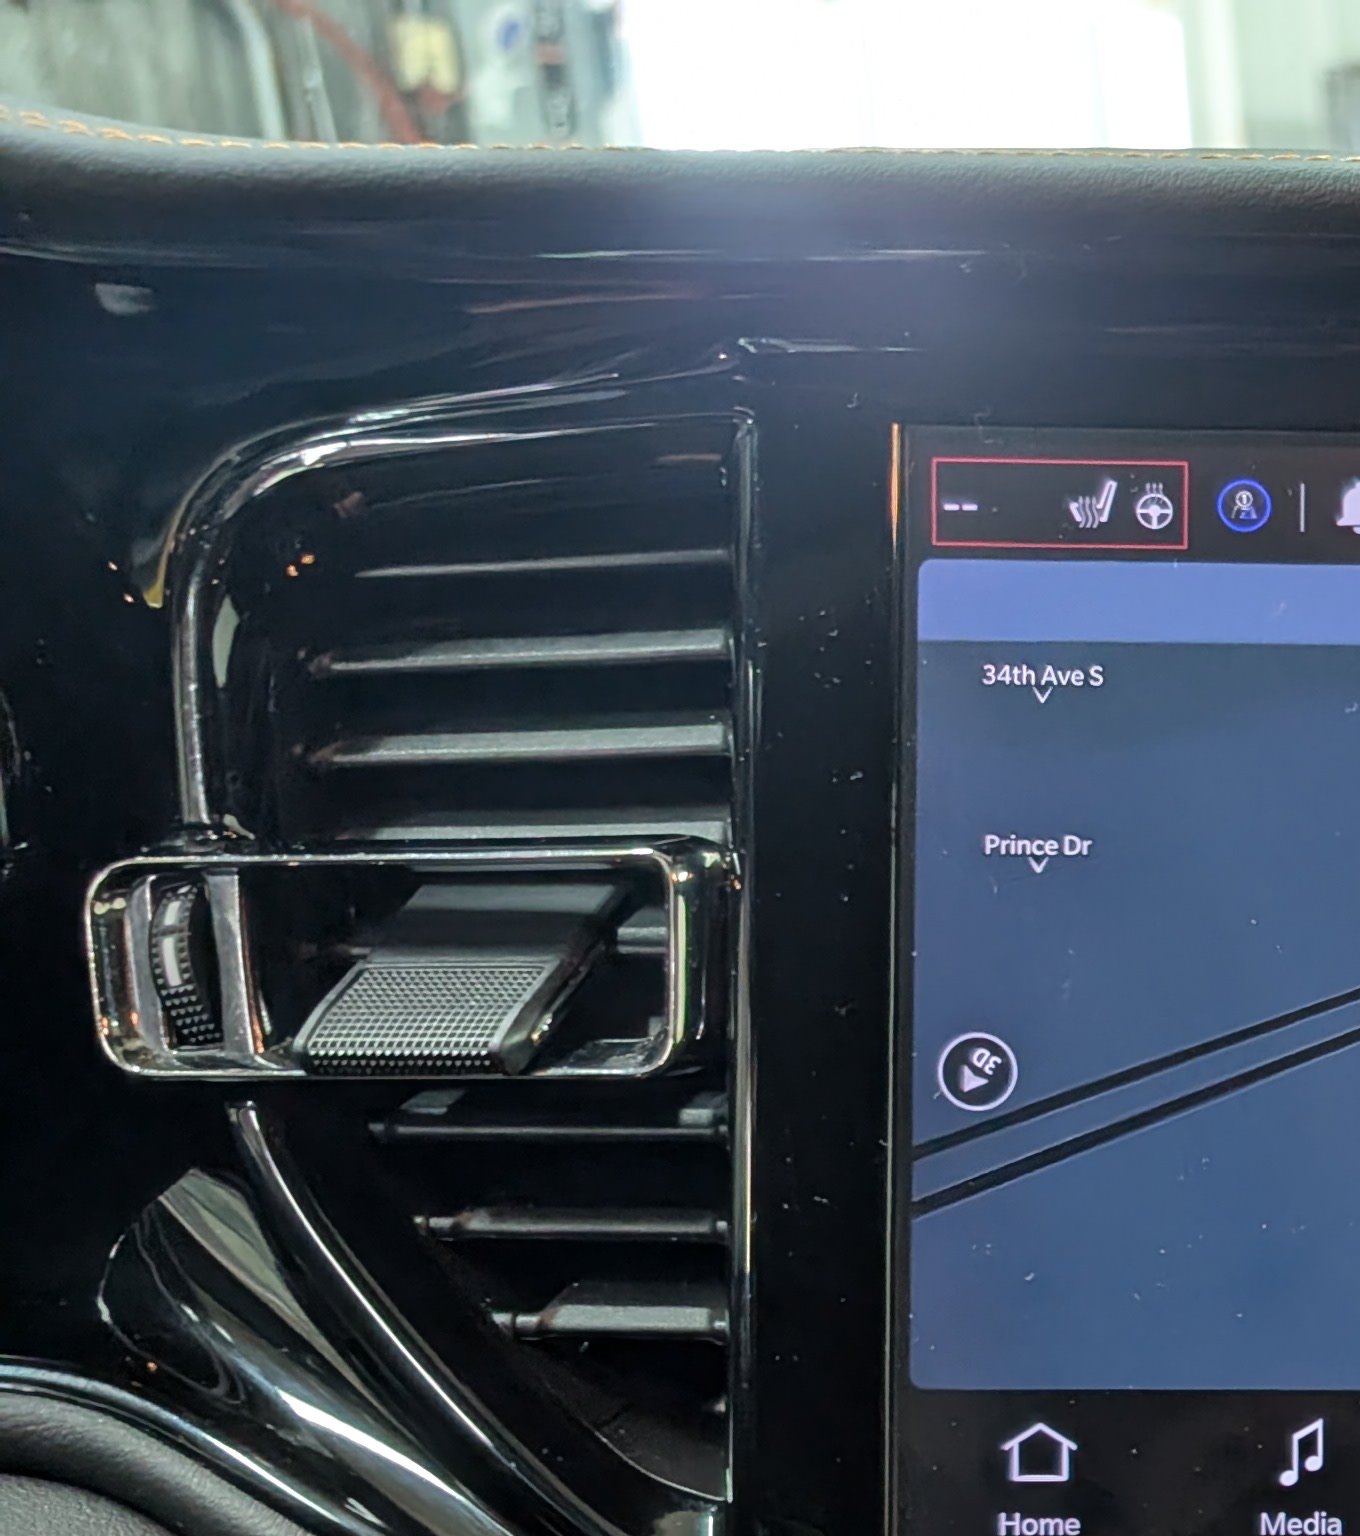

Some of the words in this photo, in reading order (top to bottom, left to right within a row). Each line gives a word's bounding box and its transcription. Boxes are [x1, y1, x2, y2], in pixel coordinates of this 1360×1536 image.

[980, 664, 1036, 687] 34th
[1039, 664, 1085, 687] Ave
[1088, 664, 1105, 687] S
[982, 834, 1058, 858] Prince
[1061, 834, 1092, 858] Dr
[973, 1047, 1002, 1075] 3D
[997, 1511, 1082, 1536] Home
[1259, 1511, 1344, 1536] Media
